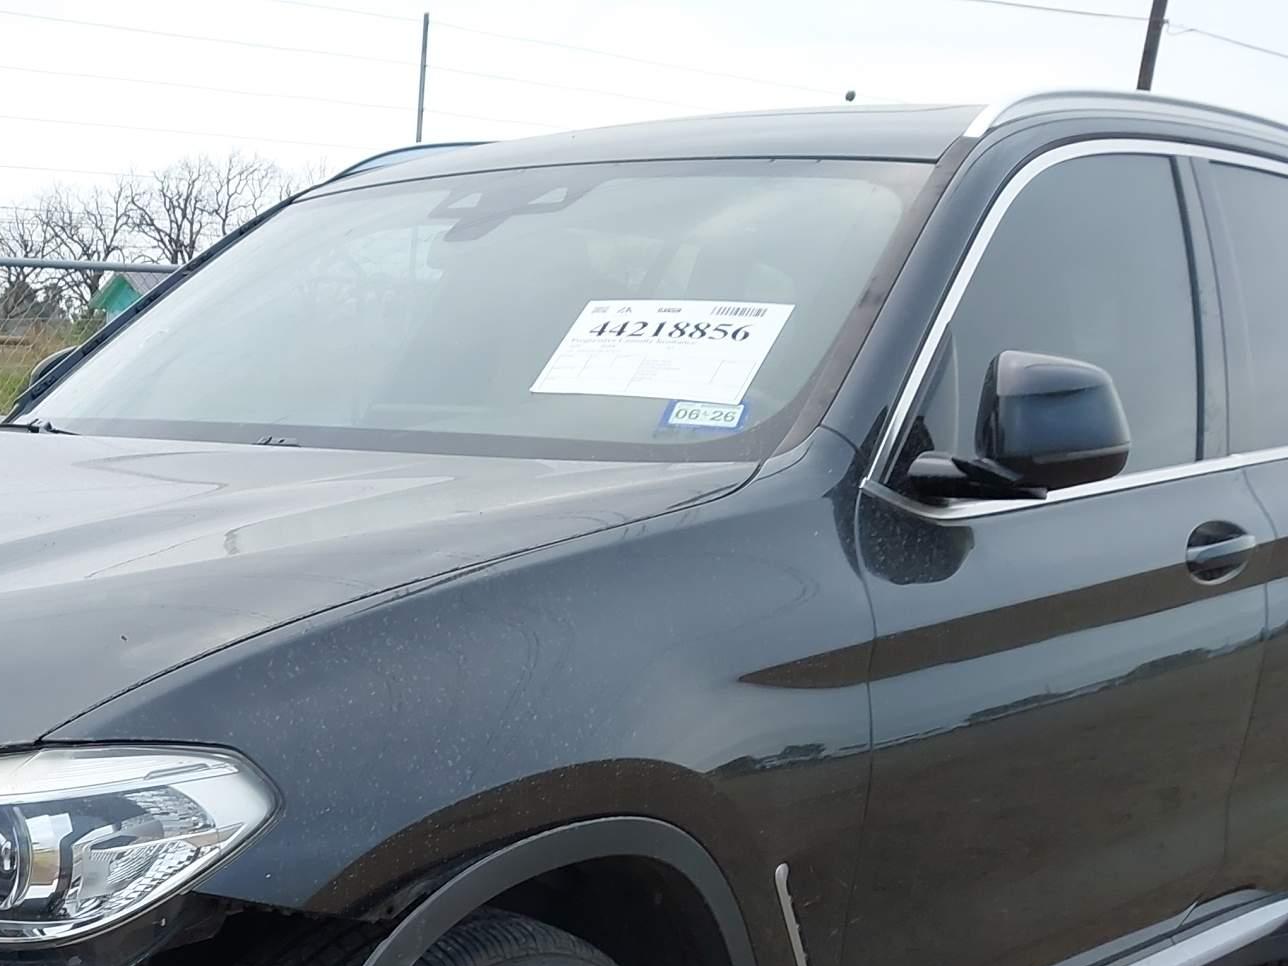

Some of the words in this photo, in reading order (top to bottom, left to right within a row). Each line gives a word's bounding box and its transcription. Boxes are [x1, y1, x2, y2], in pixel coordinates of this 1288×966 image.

[588, 320, 752, 342] 44218856
[675, 408, 701, 420] 06
[709, 410, 737, 423] 26
